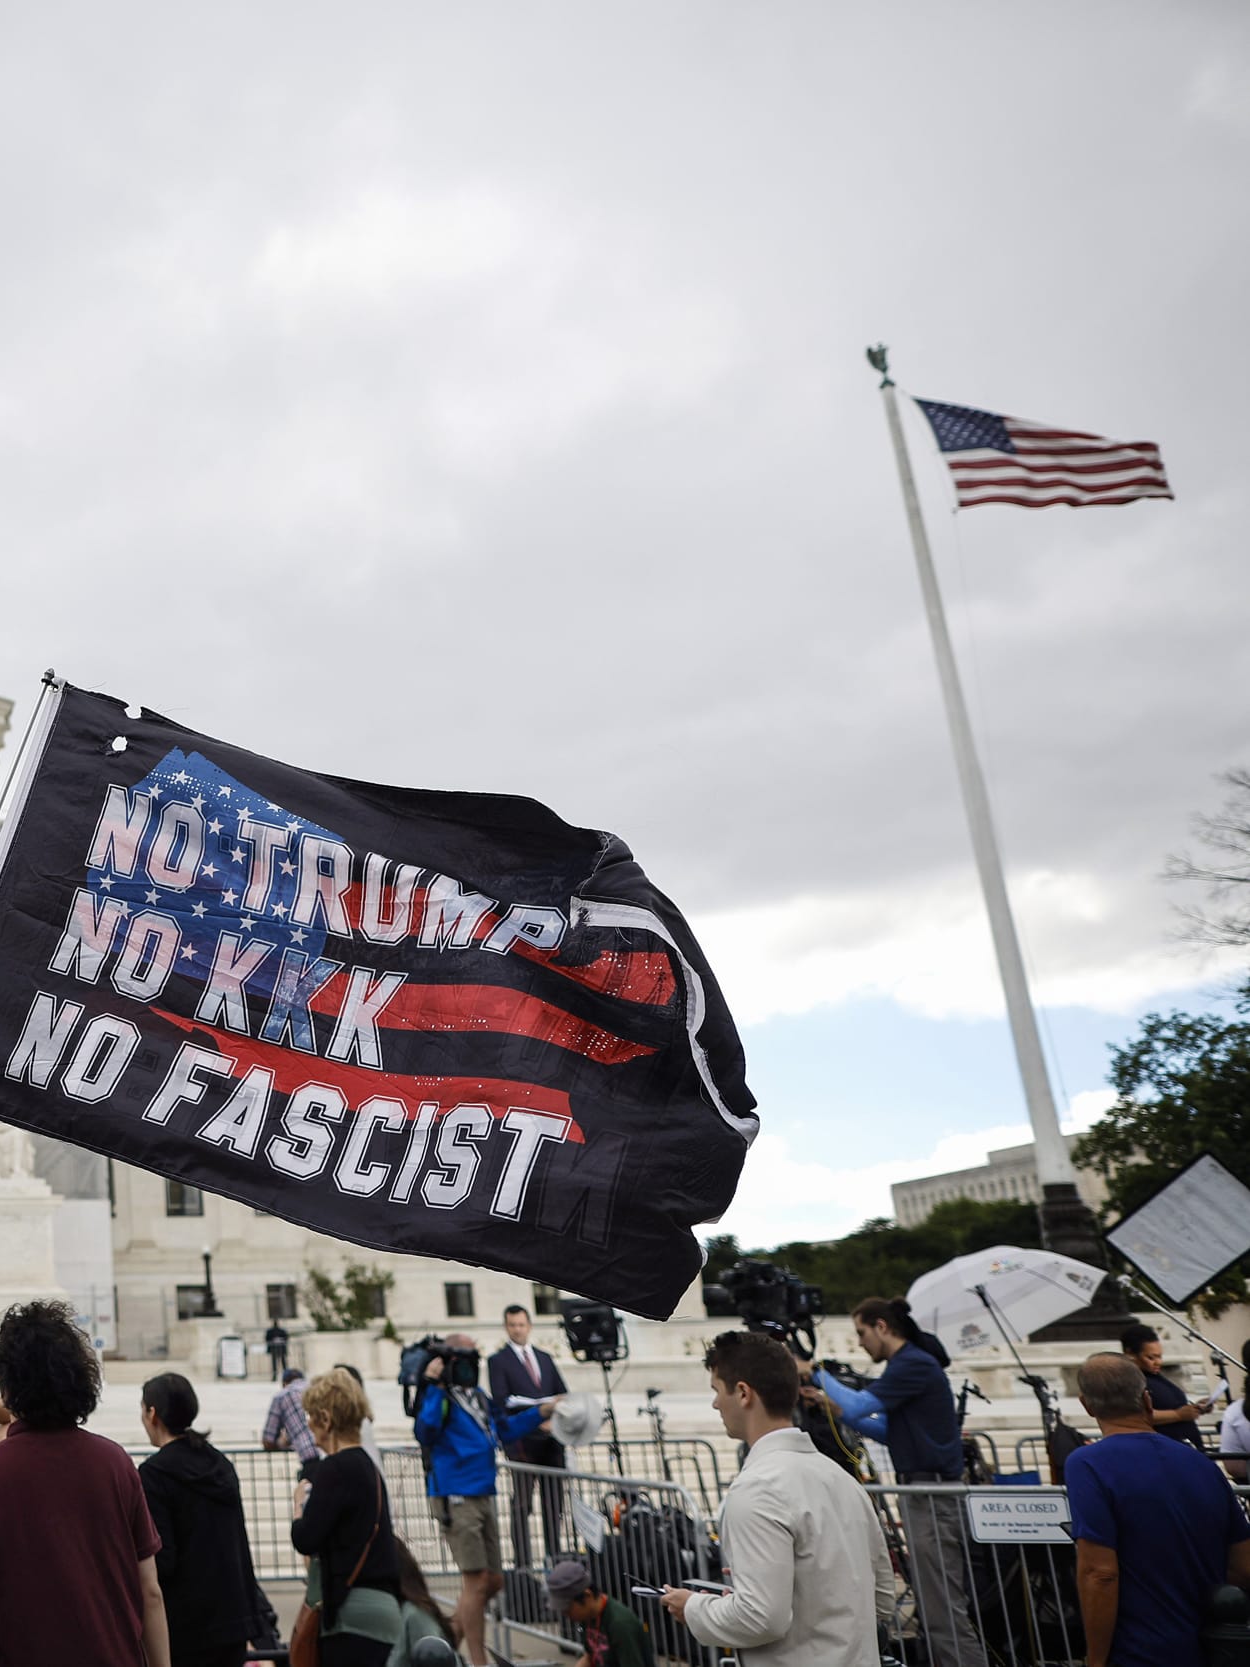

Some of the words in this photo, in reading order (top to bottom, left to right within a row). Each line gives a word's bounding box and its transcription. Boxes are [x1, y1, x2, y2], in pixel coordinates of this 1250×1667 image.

[86, 783, 205, 893] NO
[237, 820, 568, 954] TRUMP
[47, 887, 183, 1003] NO
[195, 928, 408, 1071] KKK
[4, 991, 142, 1106] NO
[141, 1039, 574, 1222] FASCIST
[980, 1503, 1012, 1514] AREA
[1015, 1503, 1058, 1514] CLOSED
